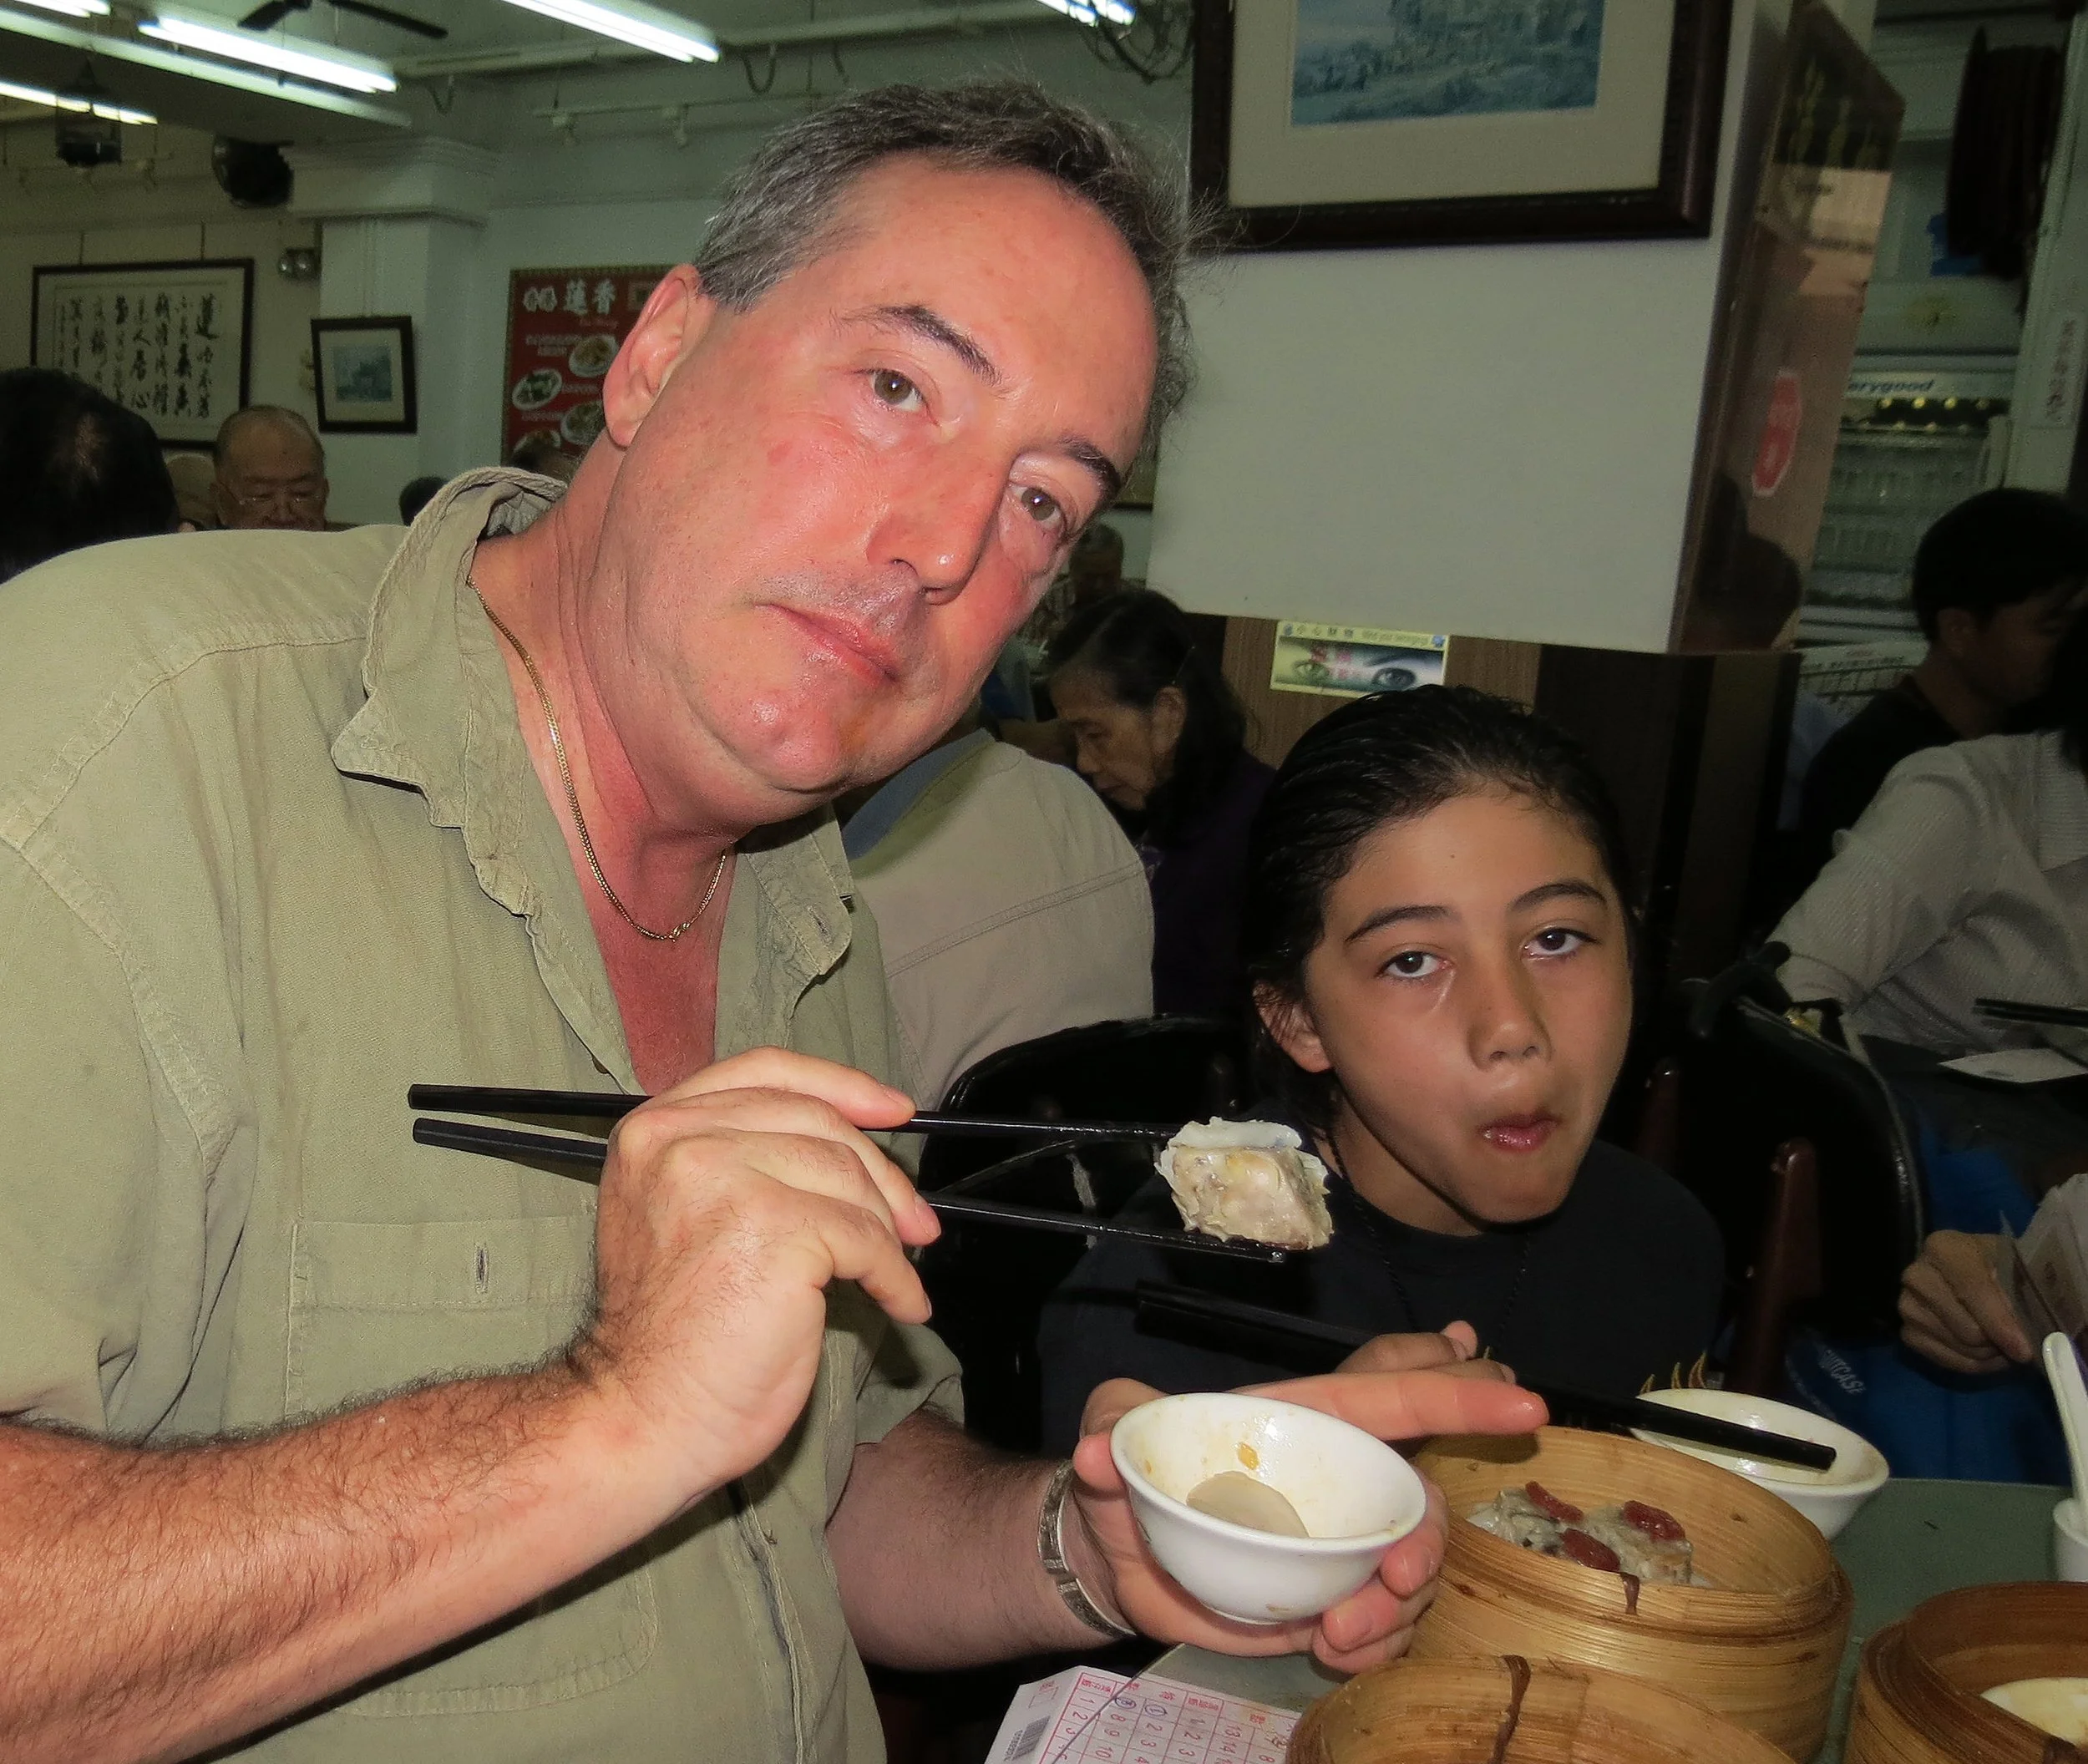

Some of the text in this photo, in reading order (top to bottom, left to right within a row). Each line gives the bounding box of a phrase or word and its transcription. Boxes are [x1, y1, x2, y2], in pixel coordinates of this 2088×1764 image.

[1072, 1711, 1088, 1721] 2
[1146, 1722, 1163, 1731] 2
[1224, 1725, 1243, 1738] 13
[1183, 1730, 1201, 1741] 2
[1140, 1739, 1157, 1748] 3
[1095, 1746, 1113, 1758] 10
[1178, 1748, 1195, 1757] 3
